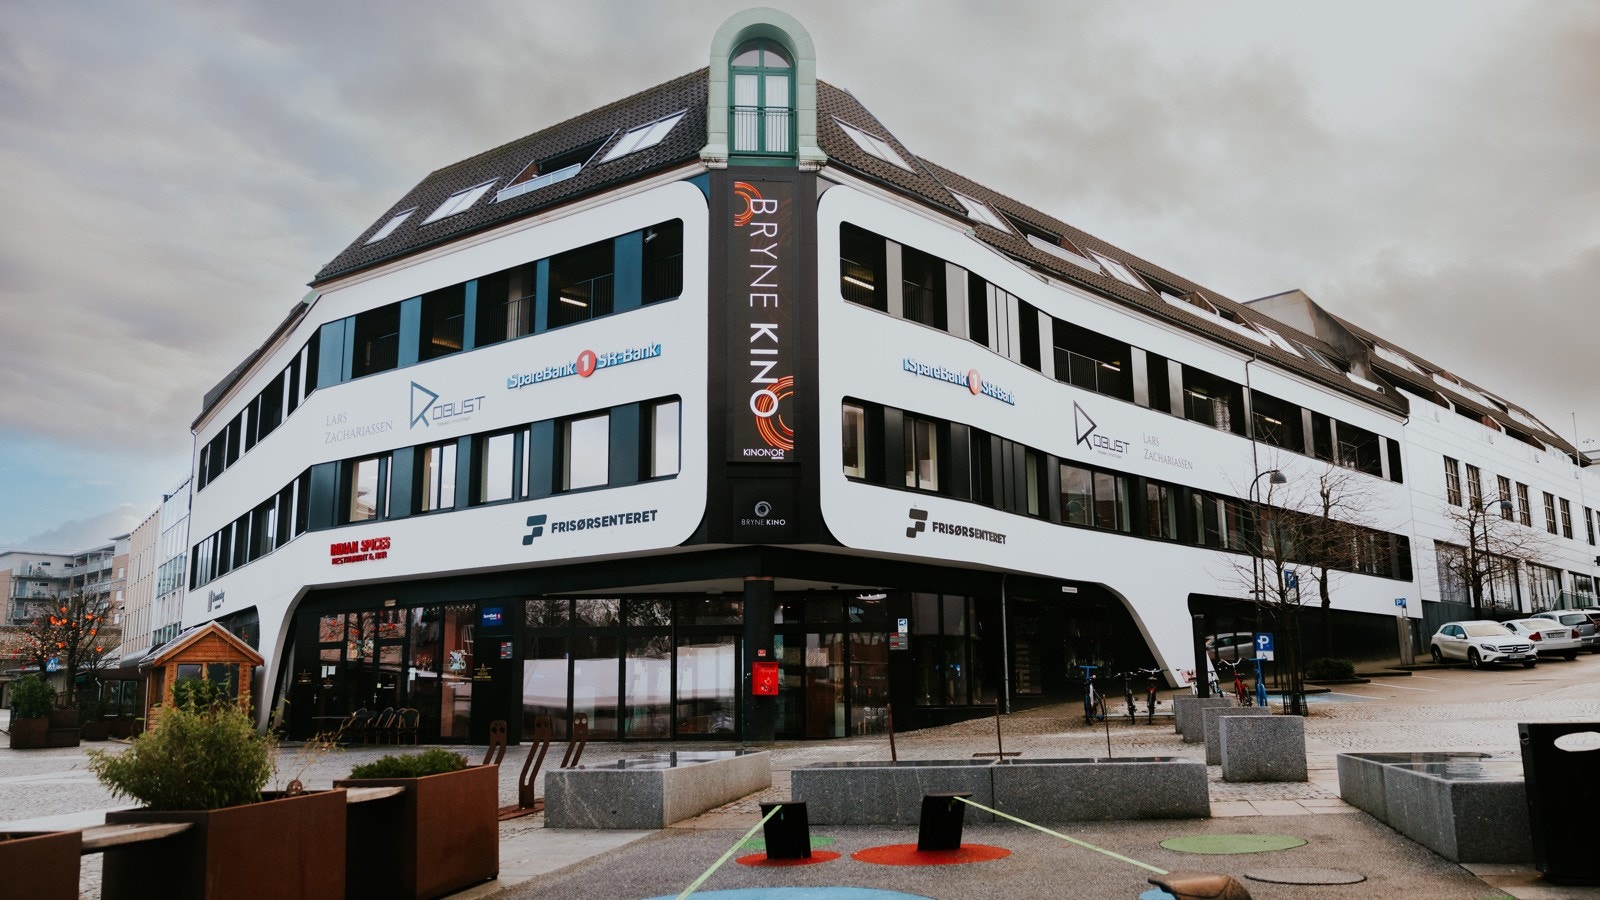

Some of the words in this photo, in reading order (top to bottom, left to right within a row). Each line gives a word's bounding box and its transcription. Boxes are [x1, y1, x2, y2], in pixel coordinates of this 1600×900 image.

[749, 198, 779, 308] BRYNE
[508, 360, 577, 390] SpareBank
[597, 341, 660, 368] SR-Bank
[749, 322, 779, 418] KINO
[904, 358, 970, 388] SpareBank
[324, 419, 394, 444] ZACHARIASSEN
[326, 412, 348, 427] LARS
[1142, 432, 1160, 447] LARS
[743, 448, 784, 457] KINONOR
[1143, 448, 1193, 471] ZACHARIASSEN
[551, 509, 658, 534] FRISØRSENTERET
[932, 521, 1007, 545] FRISØRSENTERET
[330, 540, 359, 556] INDIAN
[360, 536, 391, 552] SPICES
[1259, 635, 1270, 650] P
